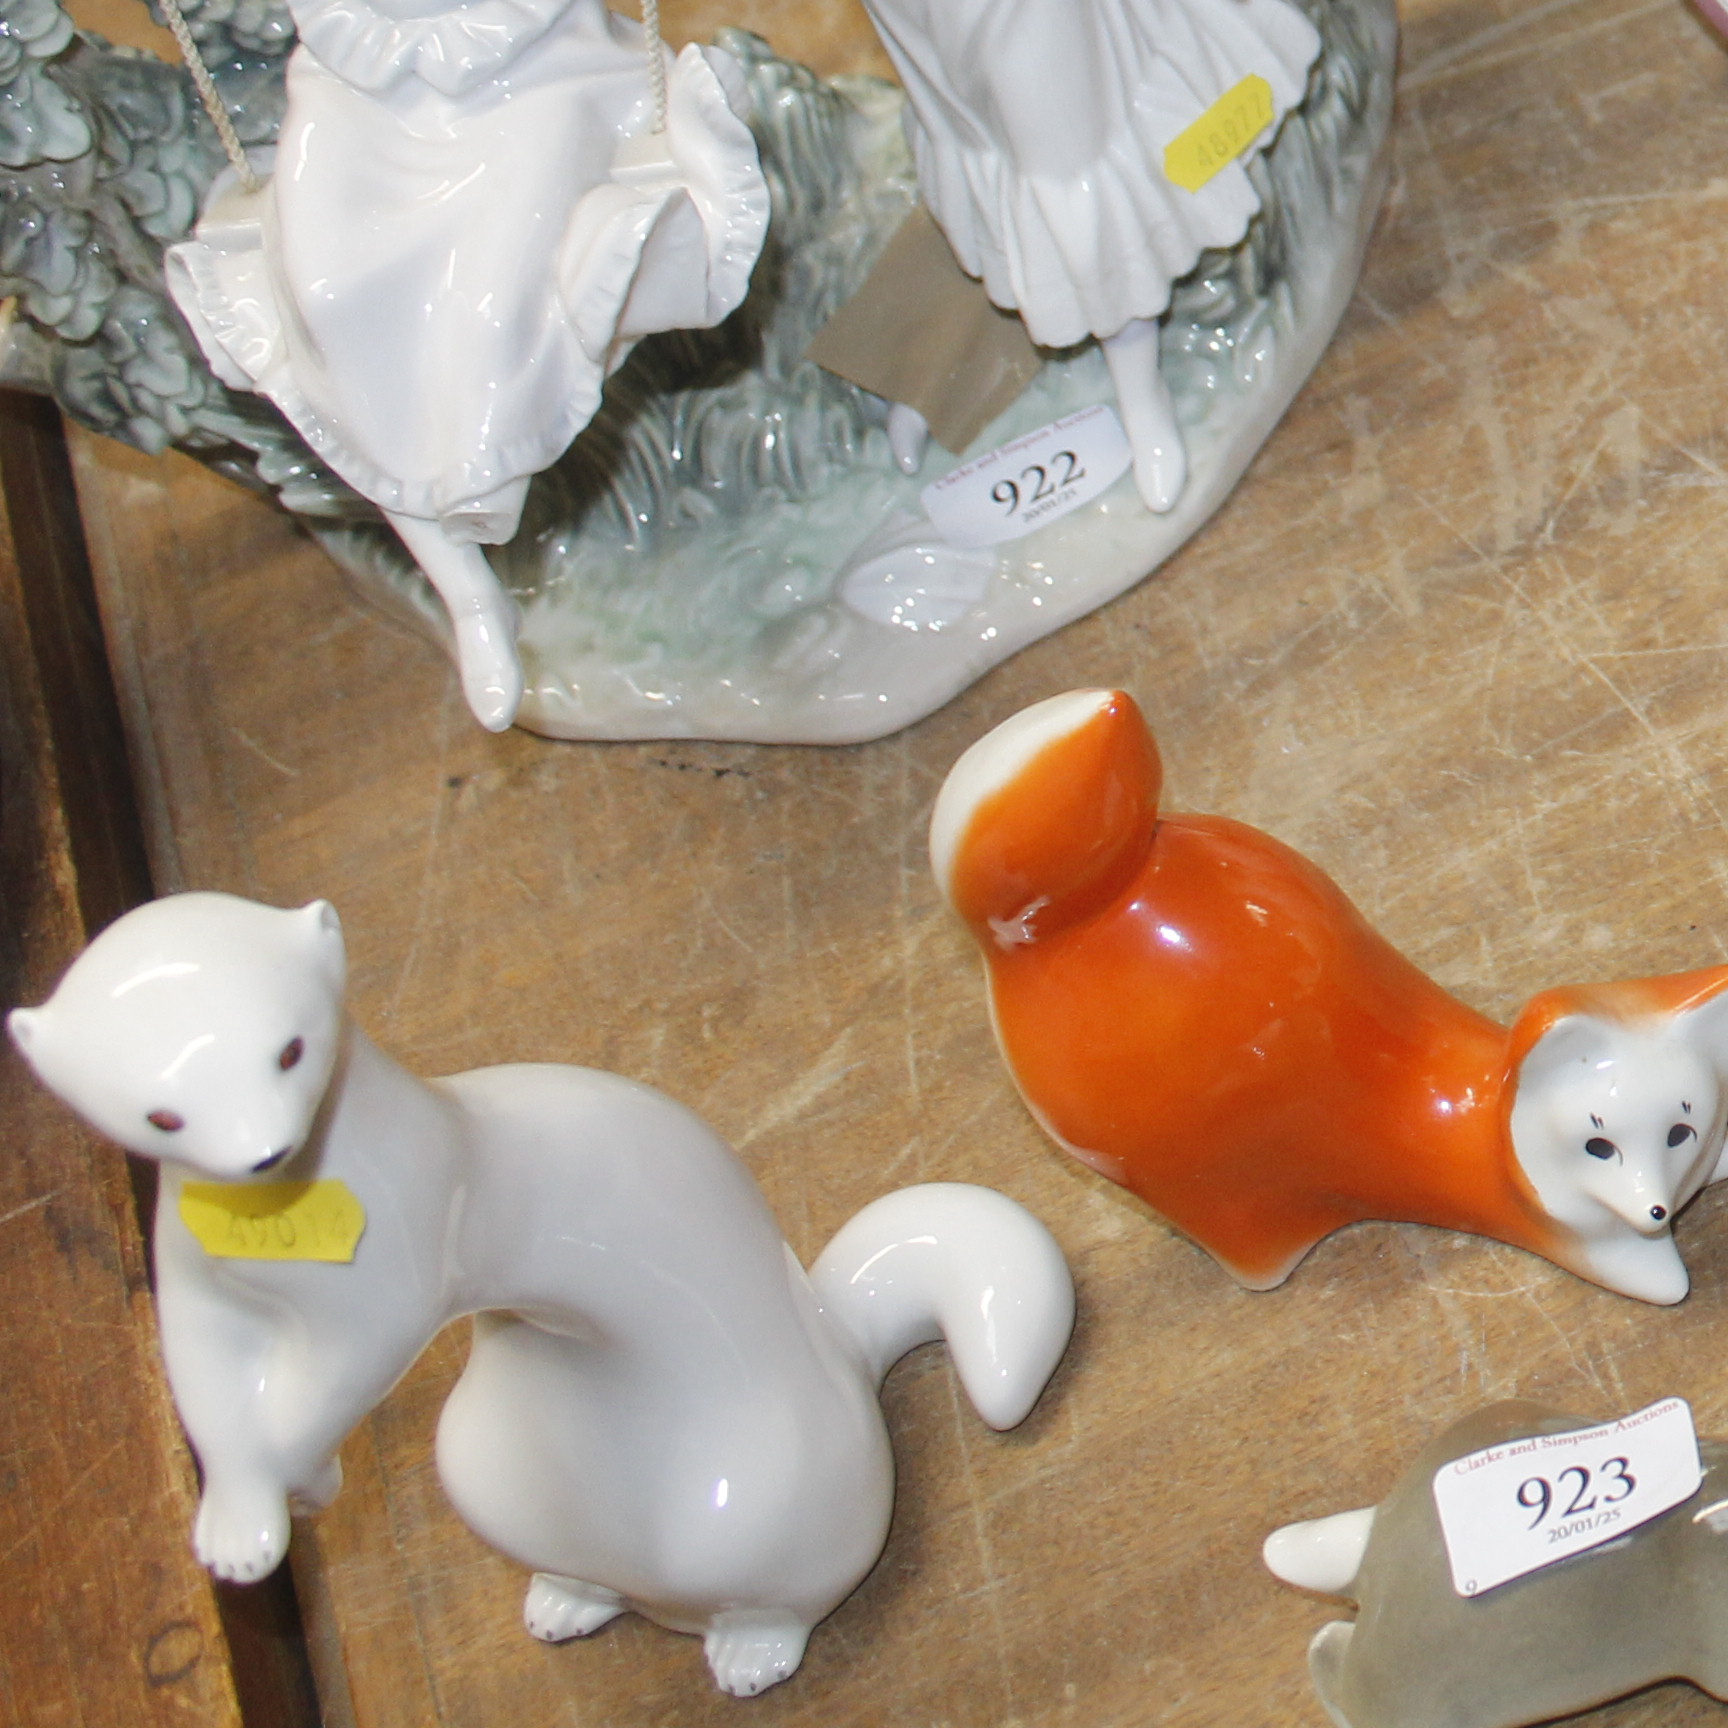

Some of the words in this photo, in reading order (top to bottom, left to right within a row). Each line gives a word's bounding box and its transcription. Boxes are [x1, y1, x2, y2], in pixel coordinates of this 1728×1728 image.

[1196, 92, 1263, 167] 48977
[990, 449, 1087, 517] 922
[1454, 1449, 1505, 1477] Clarke
[1509, 1438, 1537, 1456] and
[1542, 1428, 1609, 1451] Simpson
[1614, 1399, 1680, 1433] Auctions
[1516, 1455, 1637, 1532] 923
[1548, 1508, 1621, 1545] 20/01/25
